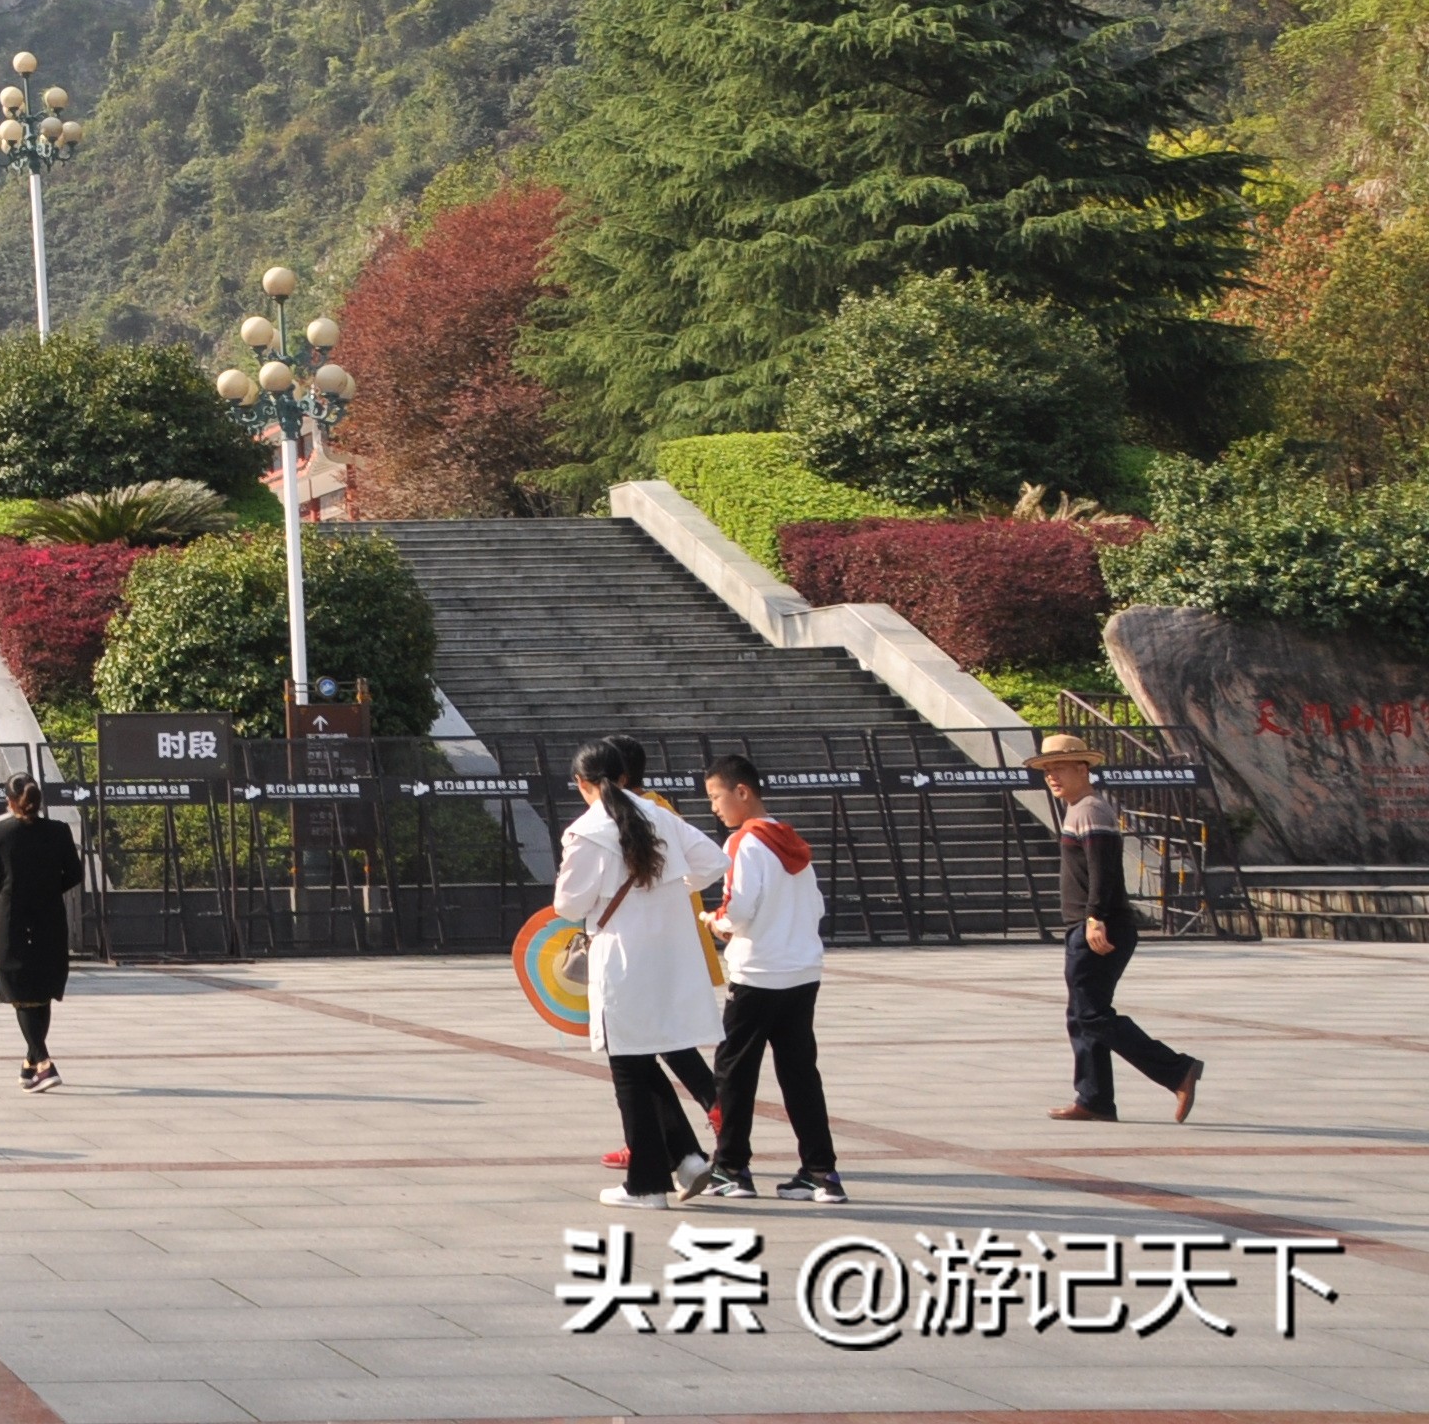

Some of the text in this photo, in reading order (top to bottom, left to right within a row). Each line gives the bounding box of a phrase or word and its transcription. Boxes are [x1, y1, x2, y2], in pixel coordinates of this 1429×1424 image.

[1254, 699, 1429, 737] 天門山國
[157, 731, 218, 759] 时段
